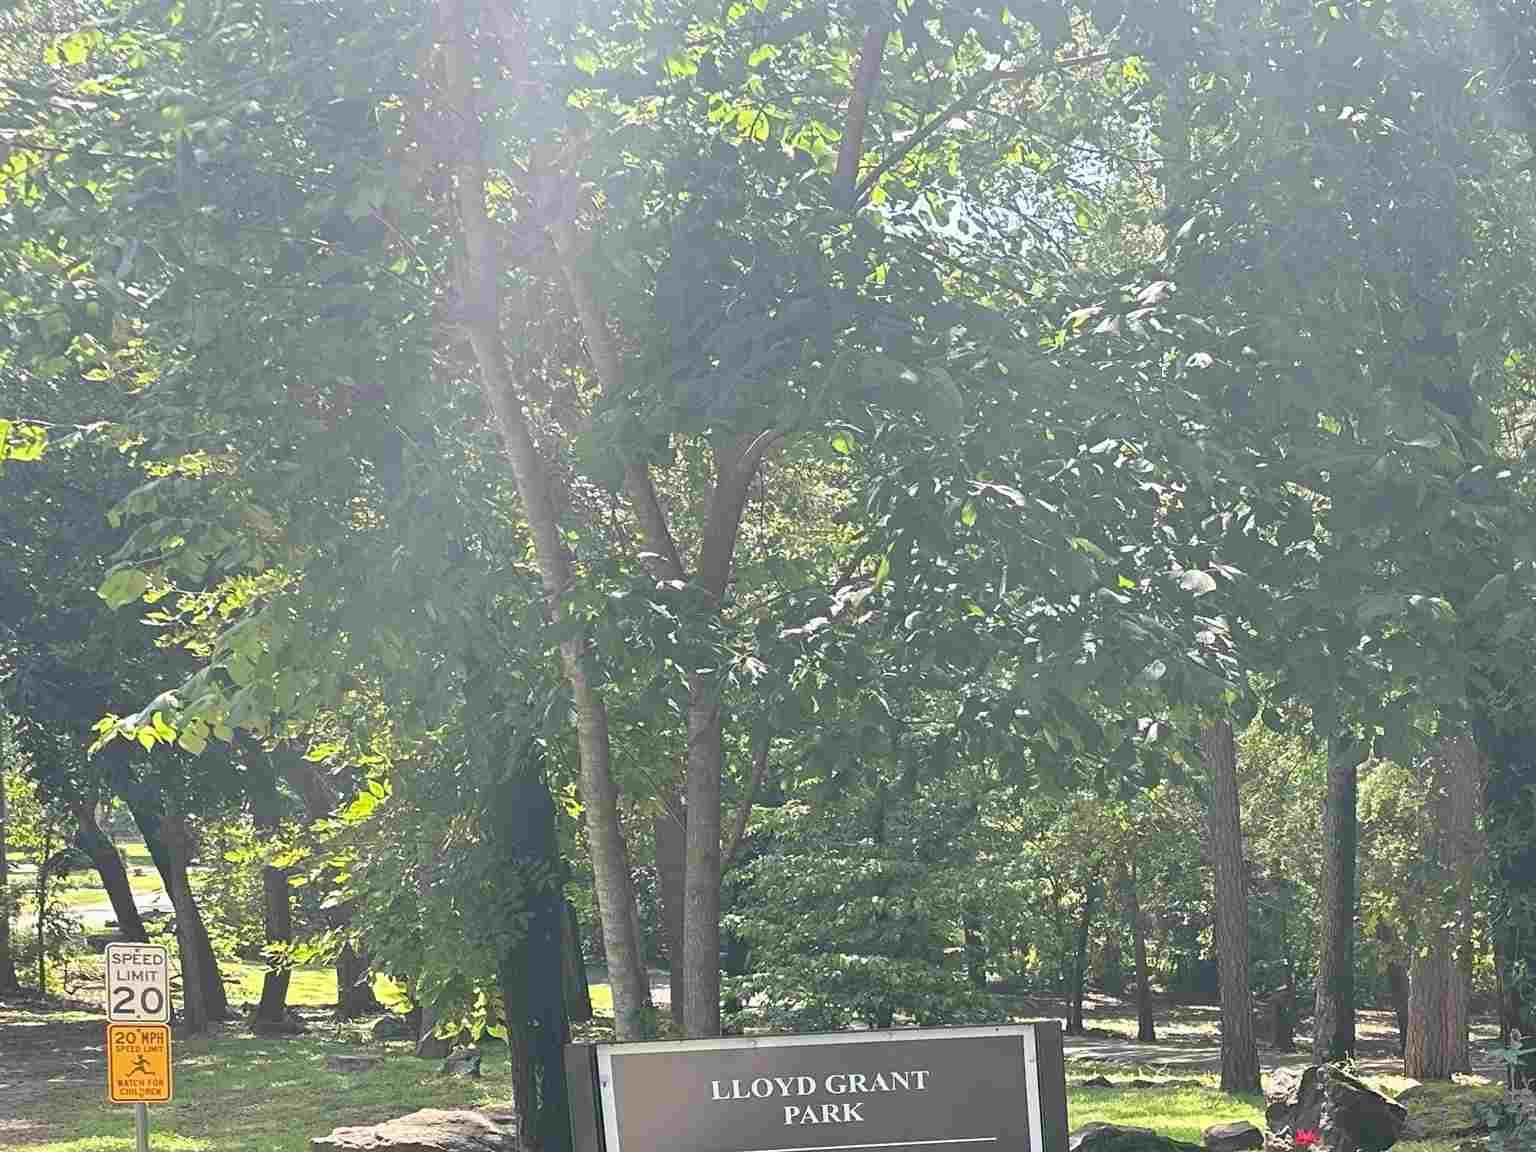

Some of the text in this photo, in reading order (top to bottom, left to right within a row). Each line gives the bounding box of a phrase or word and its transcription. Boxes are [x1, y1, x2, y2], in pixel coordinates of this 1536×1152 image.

[111, 953, 164, 966] SPEED
[116, 970, 159, 982] LIMIT
[112, 986, 164, 1015] 20
[114, 1031, 164, 1045] 20 MPH
[711, 1070, 930, 1100] LLOYD GRANT
[783, 1102, 865, 1126] PARK
